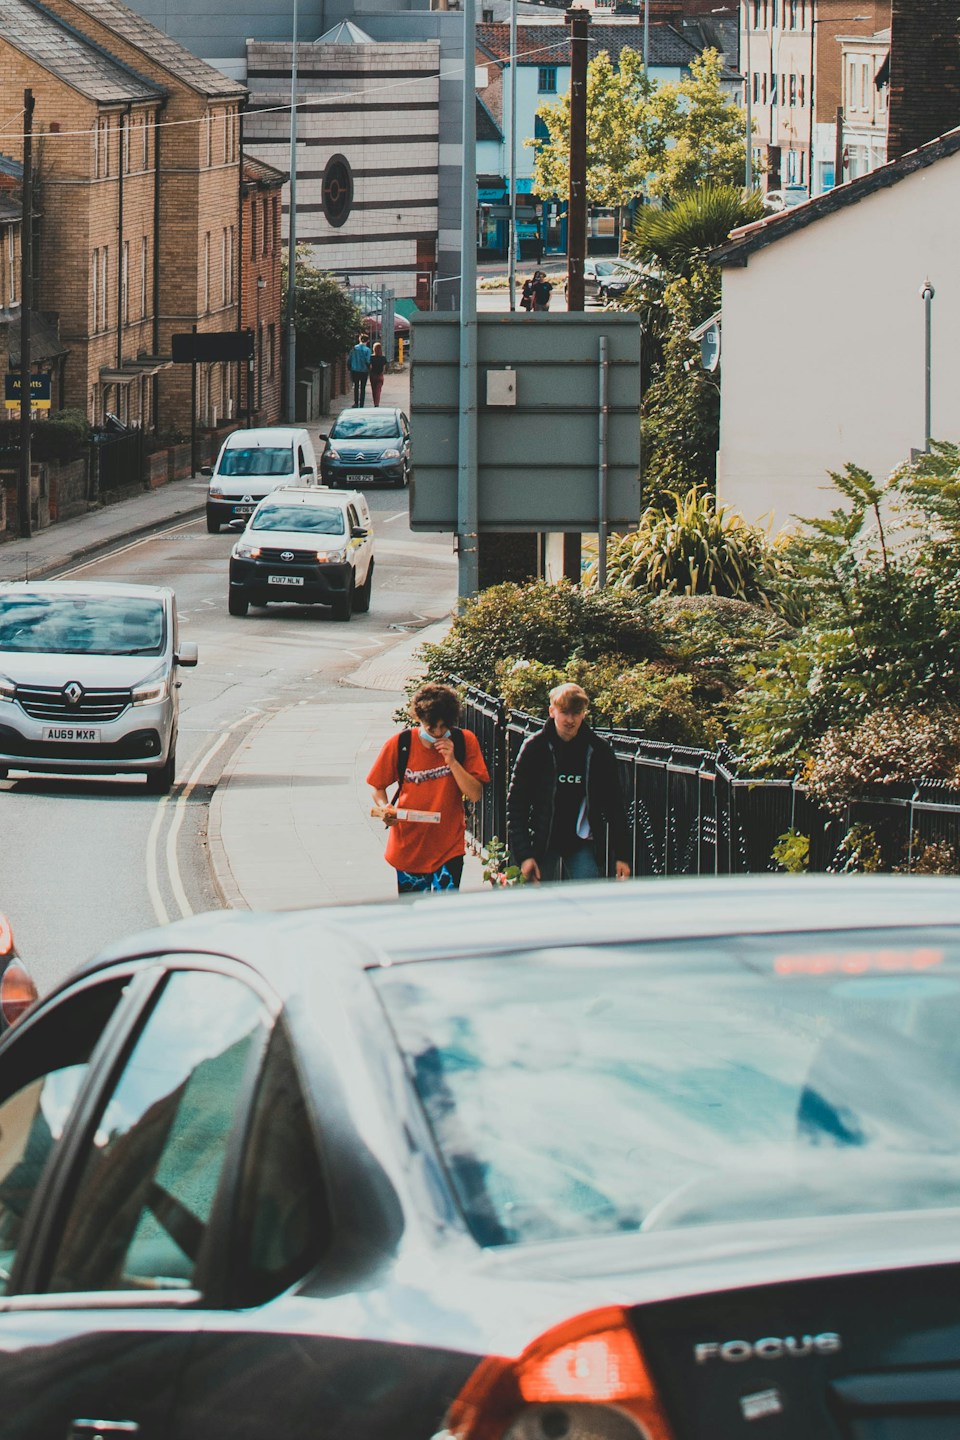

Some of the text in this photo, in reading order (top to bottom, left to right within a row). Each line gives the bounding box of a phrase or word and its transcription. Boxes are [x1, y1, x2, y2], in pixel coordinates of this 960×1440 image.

[48, 729, 96, 739] AU69 MXR
[695, 1331, 842, 1365] FOCUS
